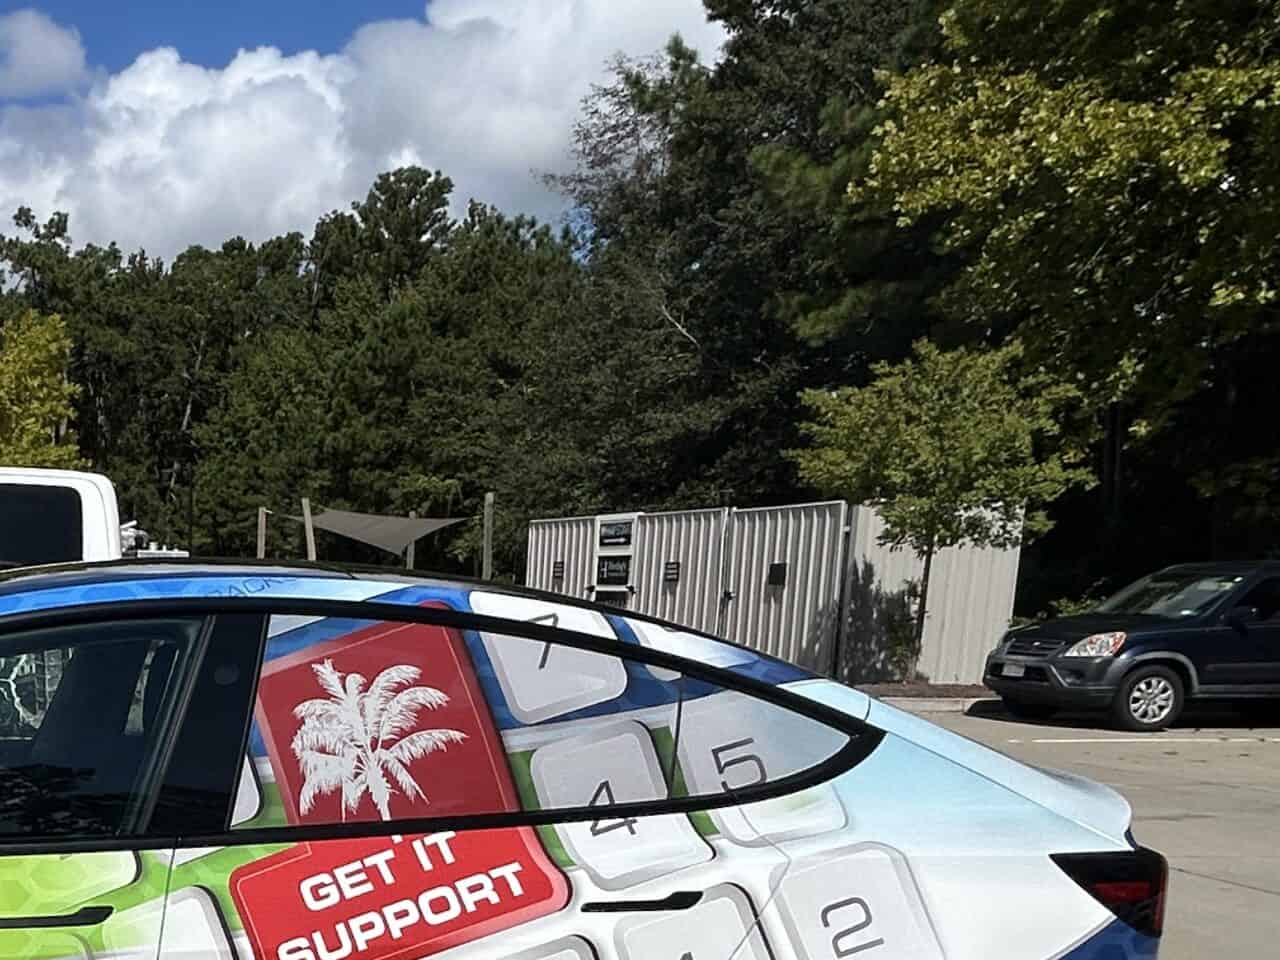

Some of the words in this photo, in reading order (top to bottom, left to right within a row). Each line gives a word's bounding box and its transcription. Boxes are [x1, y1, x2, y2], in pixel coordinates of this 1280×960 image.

[711, 737, 768, 802] 5
[588, 780, 638, 837] 4
[299, 849, 397, 912] GET
[412, 830, 457, 872] IT
[821, 896, 885, 959] 2
